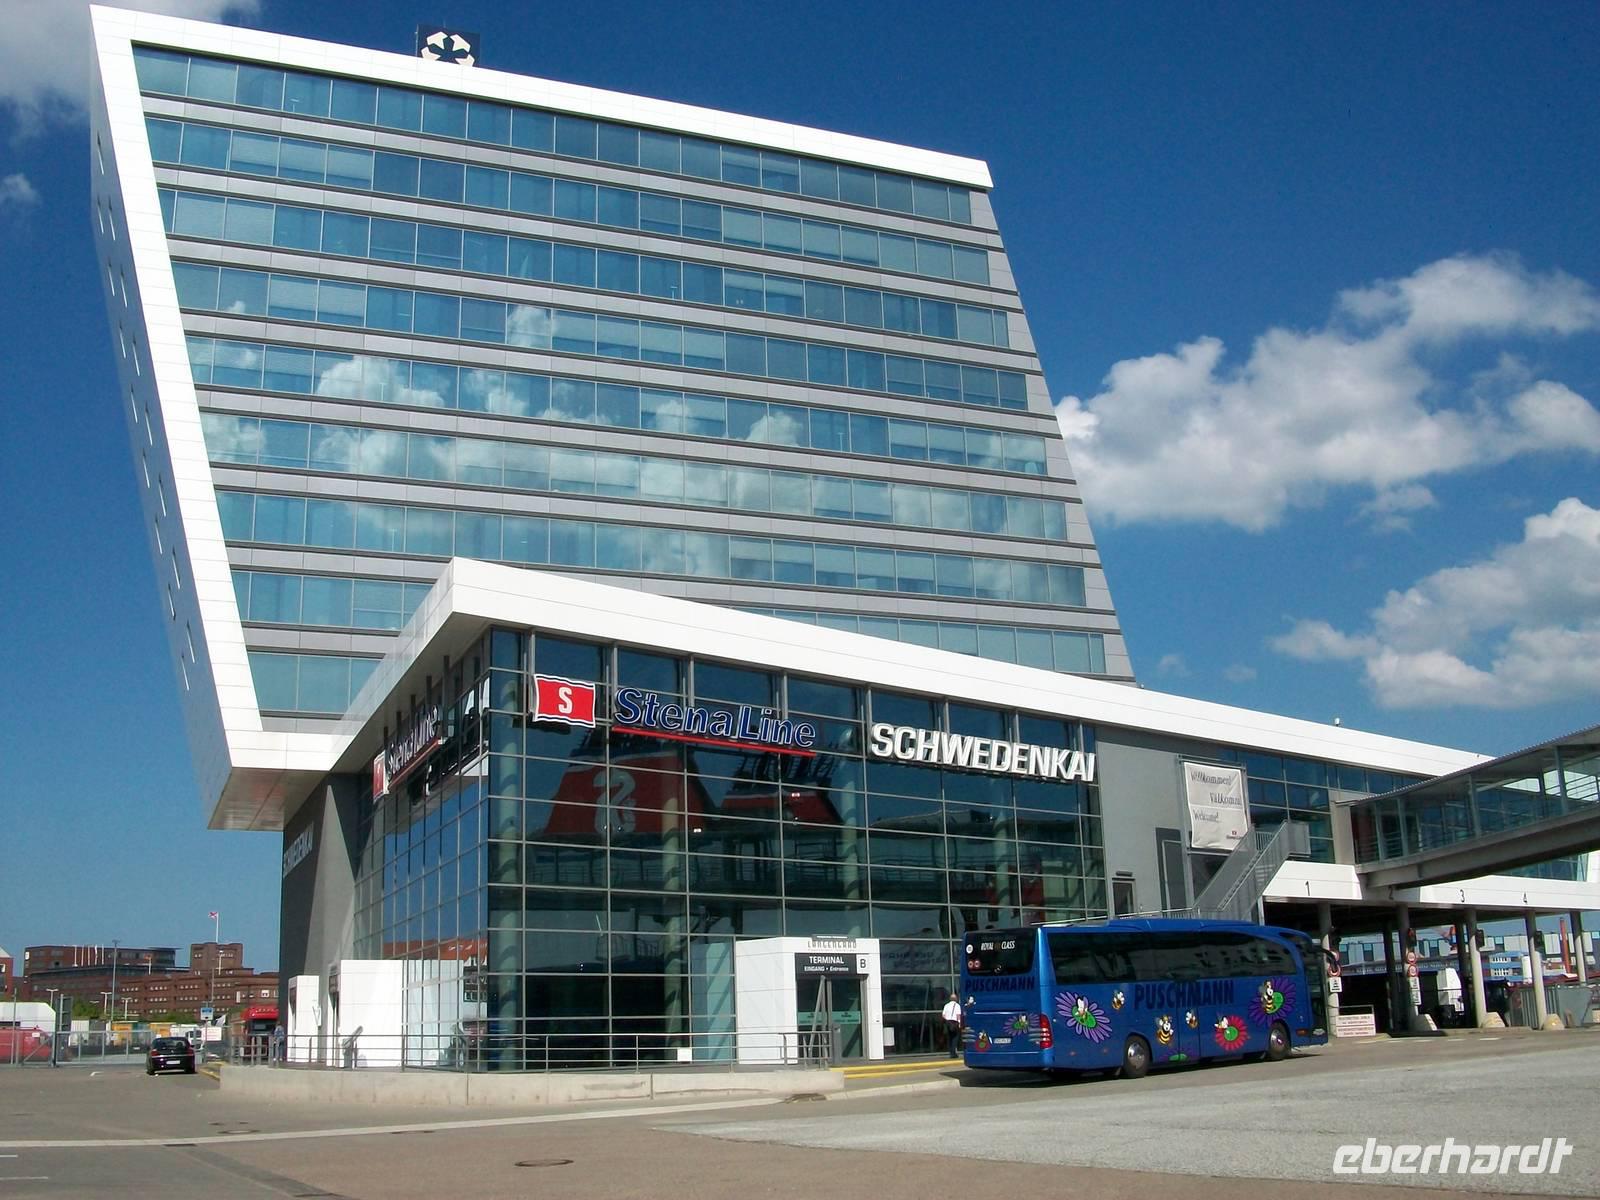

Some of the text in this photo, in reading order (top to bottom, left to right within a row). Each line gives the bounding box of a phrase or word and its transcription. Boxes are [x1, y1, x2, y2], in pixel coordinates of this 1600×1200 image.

[558, 686, 573, 713] S
[870, 723, 1096, 783] SCHWEDENKAI
[1305, 881, 1312, 896] 1
[1458, 889, 1466, 903] 3
[1522, 892, 1529, 905] 4
[1001, 941, 1016, 950] CLASS
[809, 956, 844, 964] TERMINAL
[860, 959, 867, 969] B
[965, 976, 1035, 993] PUSCHMANN
[1134, 980, 1234, 1010] PUSCHMANN
